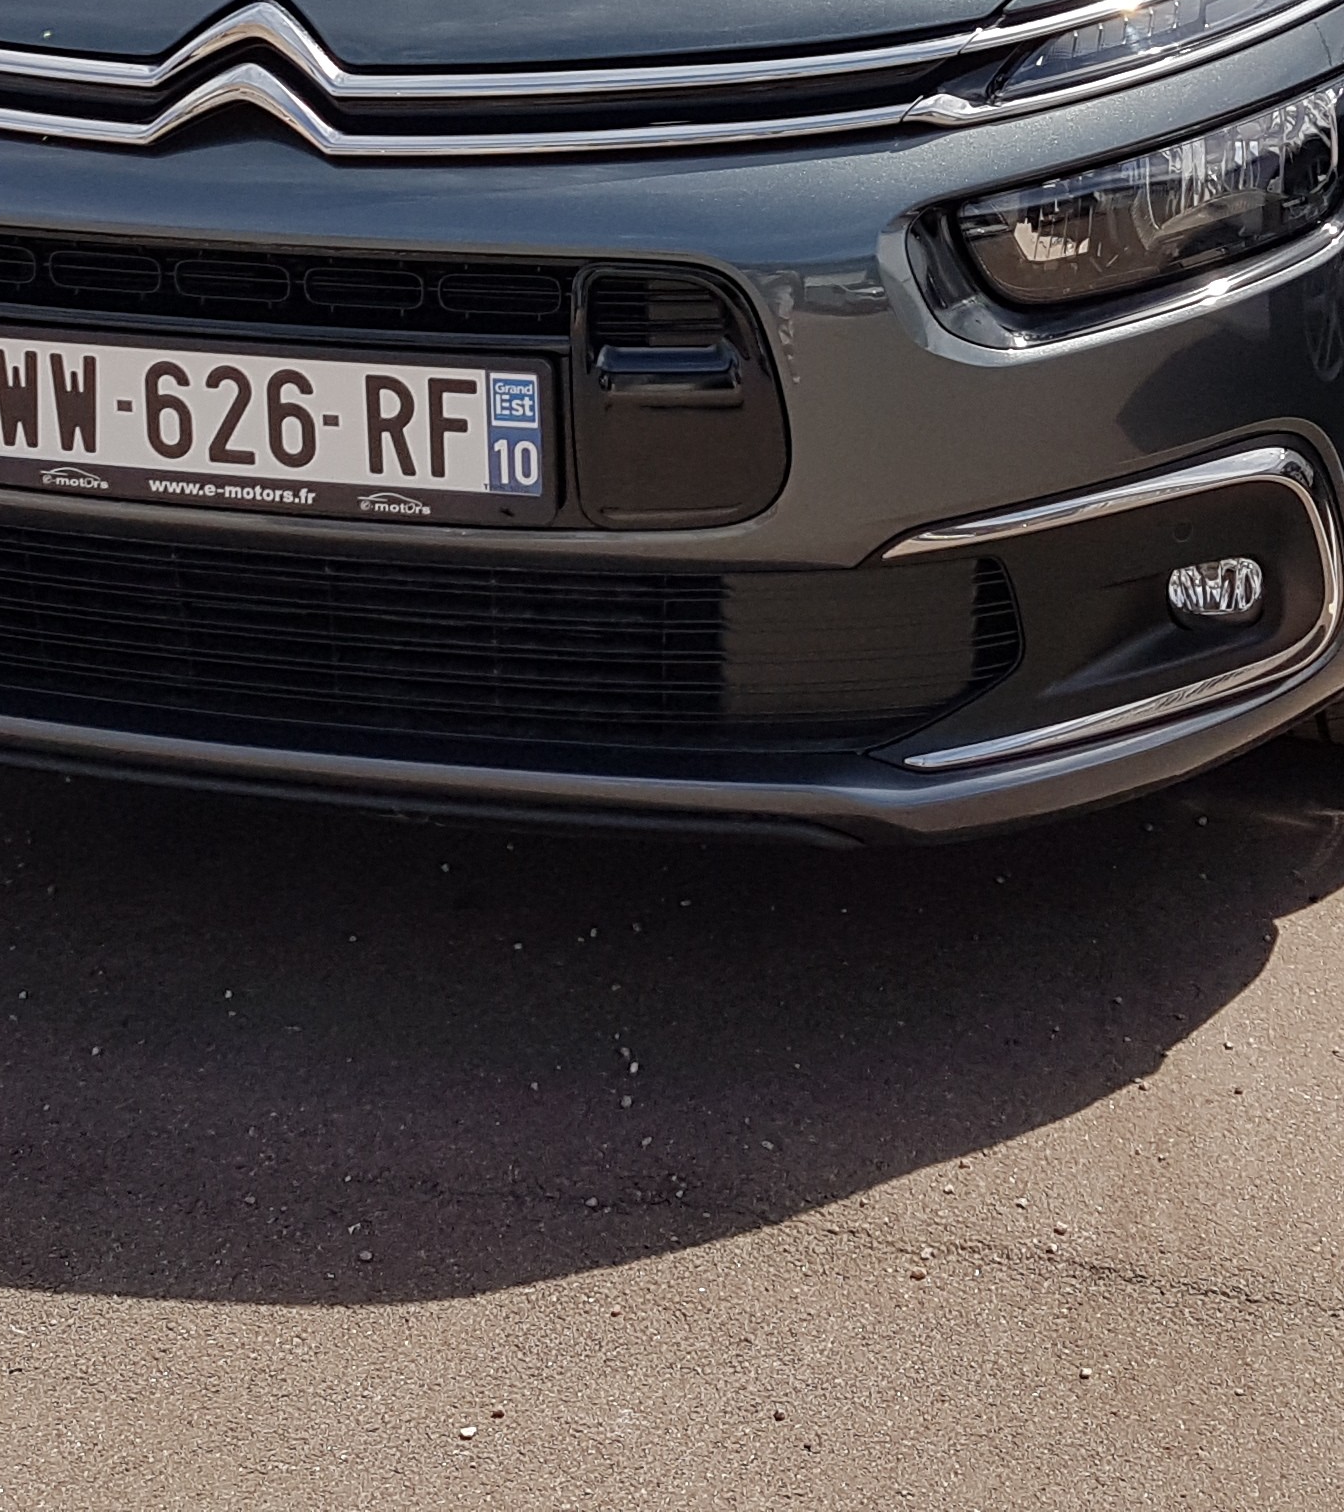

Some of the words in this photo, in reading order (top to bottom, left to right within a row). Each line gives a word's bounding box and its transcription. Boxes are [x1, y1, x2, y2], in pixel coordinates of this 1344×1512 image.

[494, 382, 533, 395] Grand
[495, 394, 534, 417] Est
[493, 438, 539, 486] 10
[148, 477, 316, 505] www.e-motors.fr
